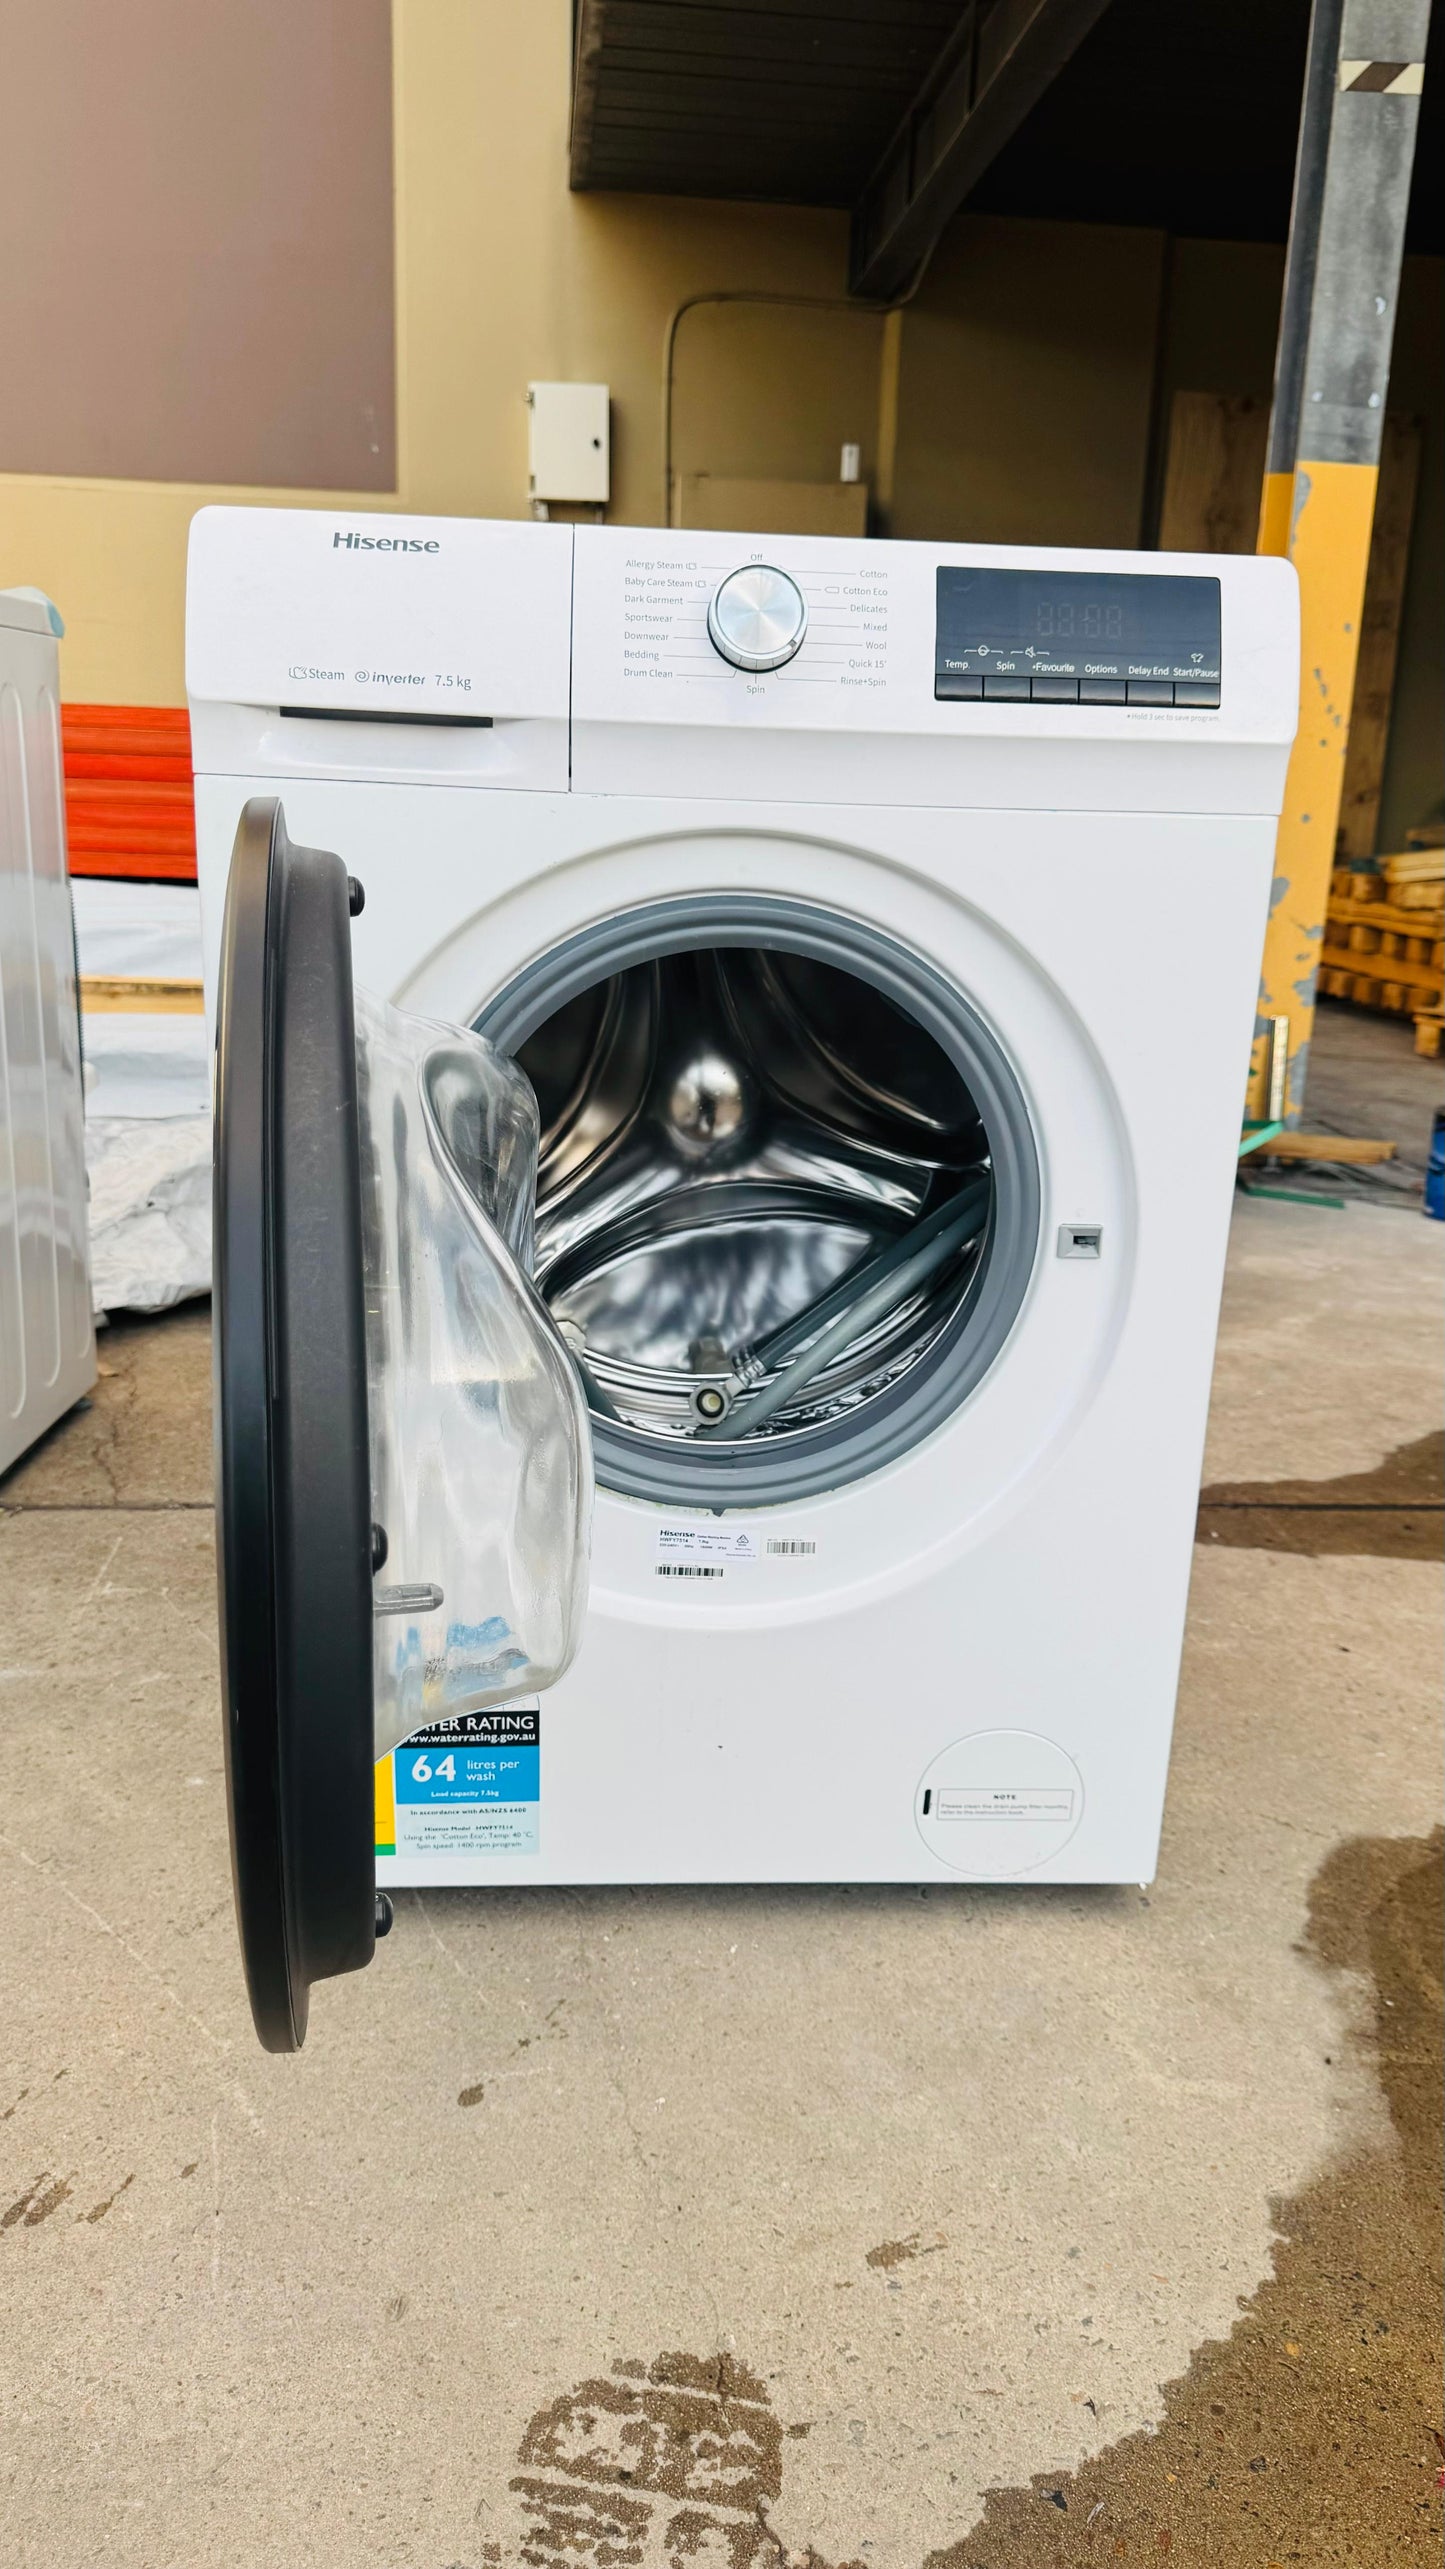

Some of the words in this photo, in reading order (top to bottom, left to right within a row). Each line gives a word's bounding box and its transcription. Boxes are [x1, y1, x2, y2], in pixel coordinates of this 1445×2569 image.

[333, 532, 440, 553] Hisense
[750, 553, 763, 562] Off
[626, 560, 655, 570] Allergy
[657, 561, 684, 569] Steam
[859, 570, 888, 579] Cotton
[624, 577, 645, 588] Baby
[647, 578, 666, 587] Care
[668, 579, 693, 588] Steam
[843, 587, 870, 596] Cotton
[872, 588, 888, 596] Eco
[624, 595, 644, 604] Dark
[646, 596, 683, 605] Garment
[850, 604, 888, 614] Delicates
[624, 613, 673, 623] Sportswear
[863, 623, 887, 632] Mixed
[624, 632, 669, 641] Downwear
[865, 641, 887, 650] Wool
[624, 650, 660, 660] Bedding
[848, 659, 873, 669] Quick
[945, 660, 970, 671] Temp.
[996, 661, 1015, 671] Spin
[1085, 664, 1118, 674] Options
[309, 668, 345, 681] Steam
[624, 668, 648, 677] Drum
[650, 669, 673, 678] Clean
[1128, 666, 1150, 676] Delay
[1152, 667, 1169, 676] End
[1173, 667, 1219, 678] Start/Pause
[372, 671, 426, 686] inverter
[435, 674, 453, 688] 7.5
[457, 676, 471, 691] kg
[840, 677, 887, 687] Rinse+Spin
[746, 685, 765, 695] Spin
[660, 1530, 695, 1538] Hisense
[466, 1716, 534, 1730] RATING
[405, 1733, 535, 1744] ww.waterrating.gov.au
[412, 1755, 456, 1783] 64
[467, 1760, 496, 1769] litres
[500, 1761, 519, 1771] per
[466, 1772, 496, 1781] wash
